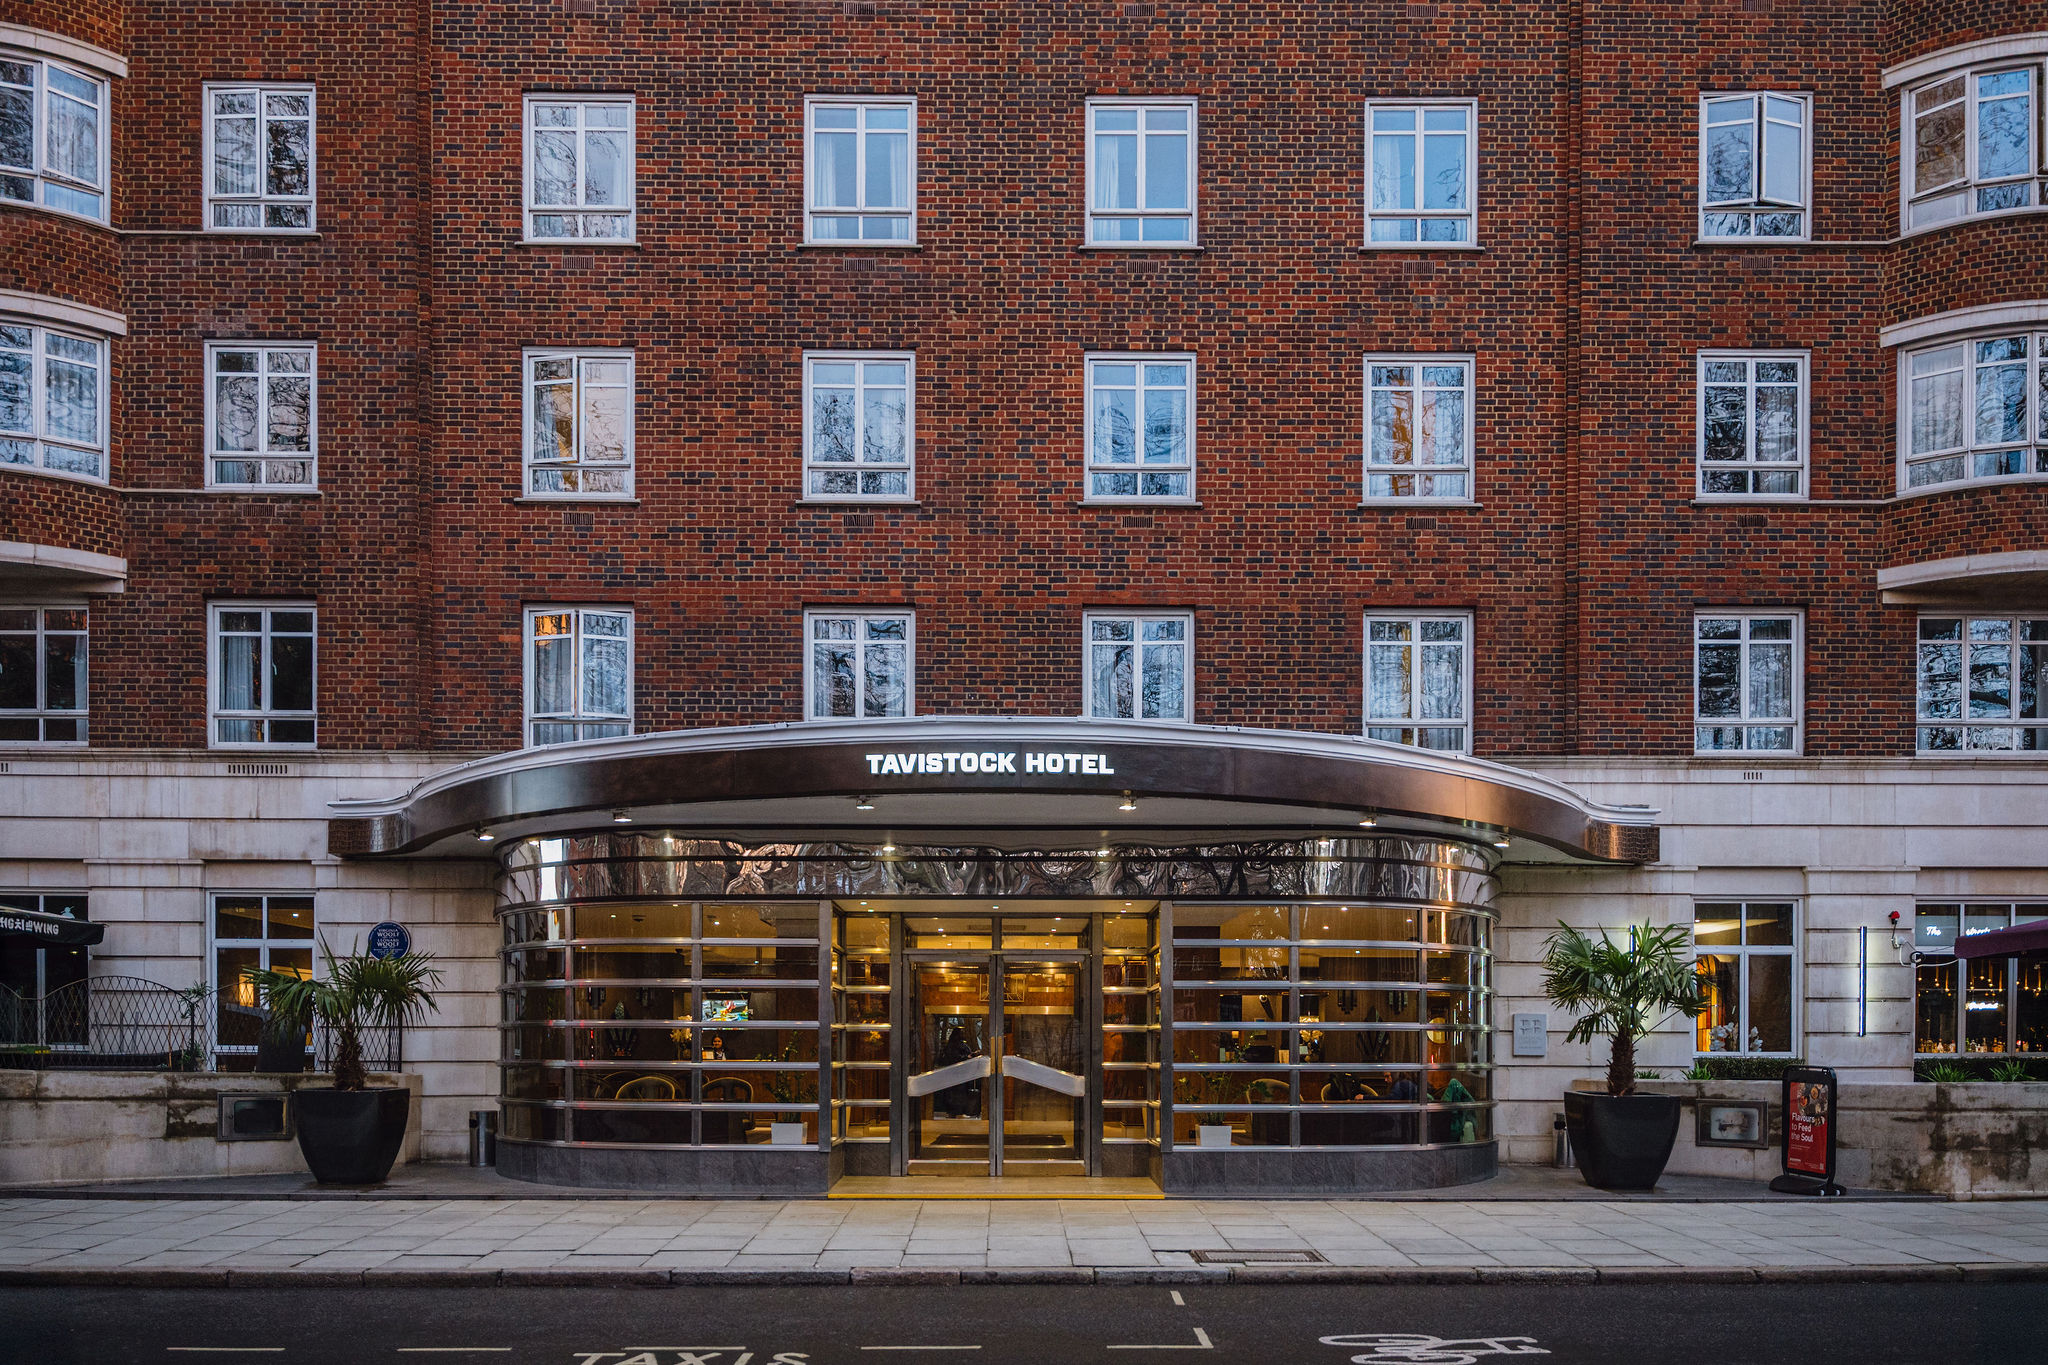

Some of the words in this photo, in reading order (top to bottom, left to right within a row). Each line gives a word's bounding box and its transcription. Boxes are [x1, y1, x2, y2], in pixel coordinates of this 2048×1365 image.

[865, 752, 1016, 774] TAVISTOCK
[1025, 753, 1115, 775] HOTEL
[1791, 1112, 1815, 1123] Flavours
[1791, 1122, 1797, 1131] to
[1798, 1122, 1811, 1132] Feed
[1791, 1132, 1800, 1141] the
[1800, 1133, 1813, 1142] Soul
